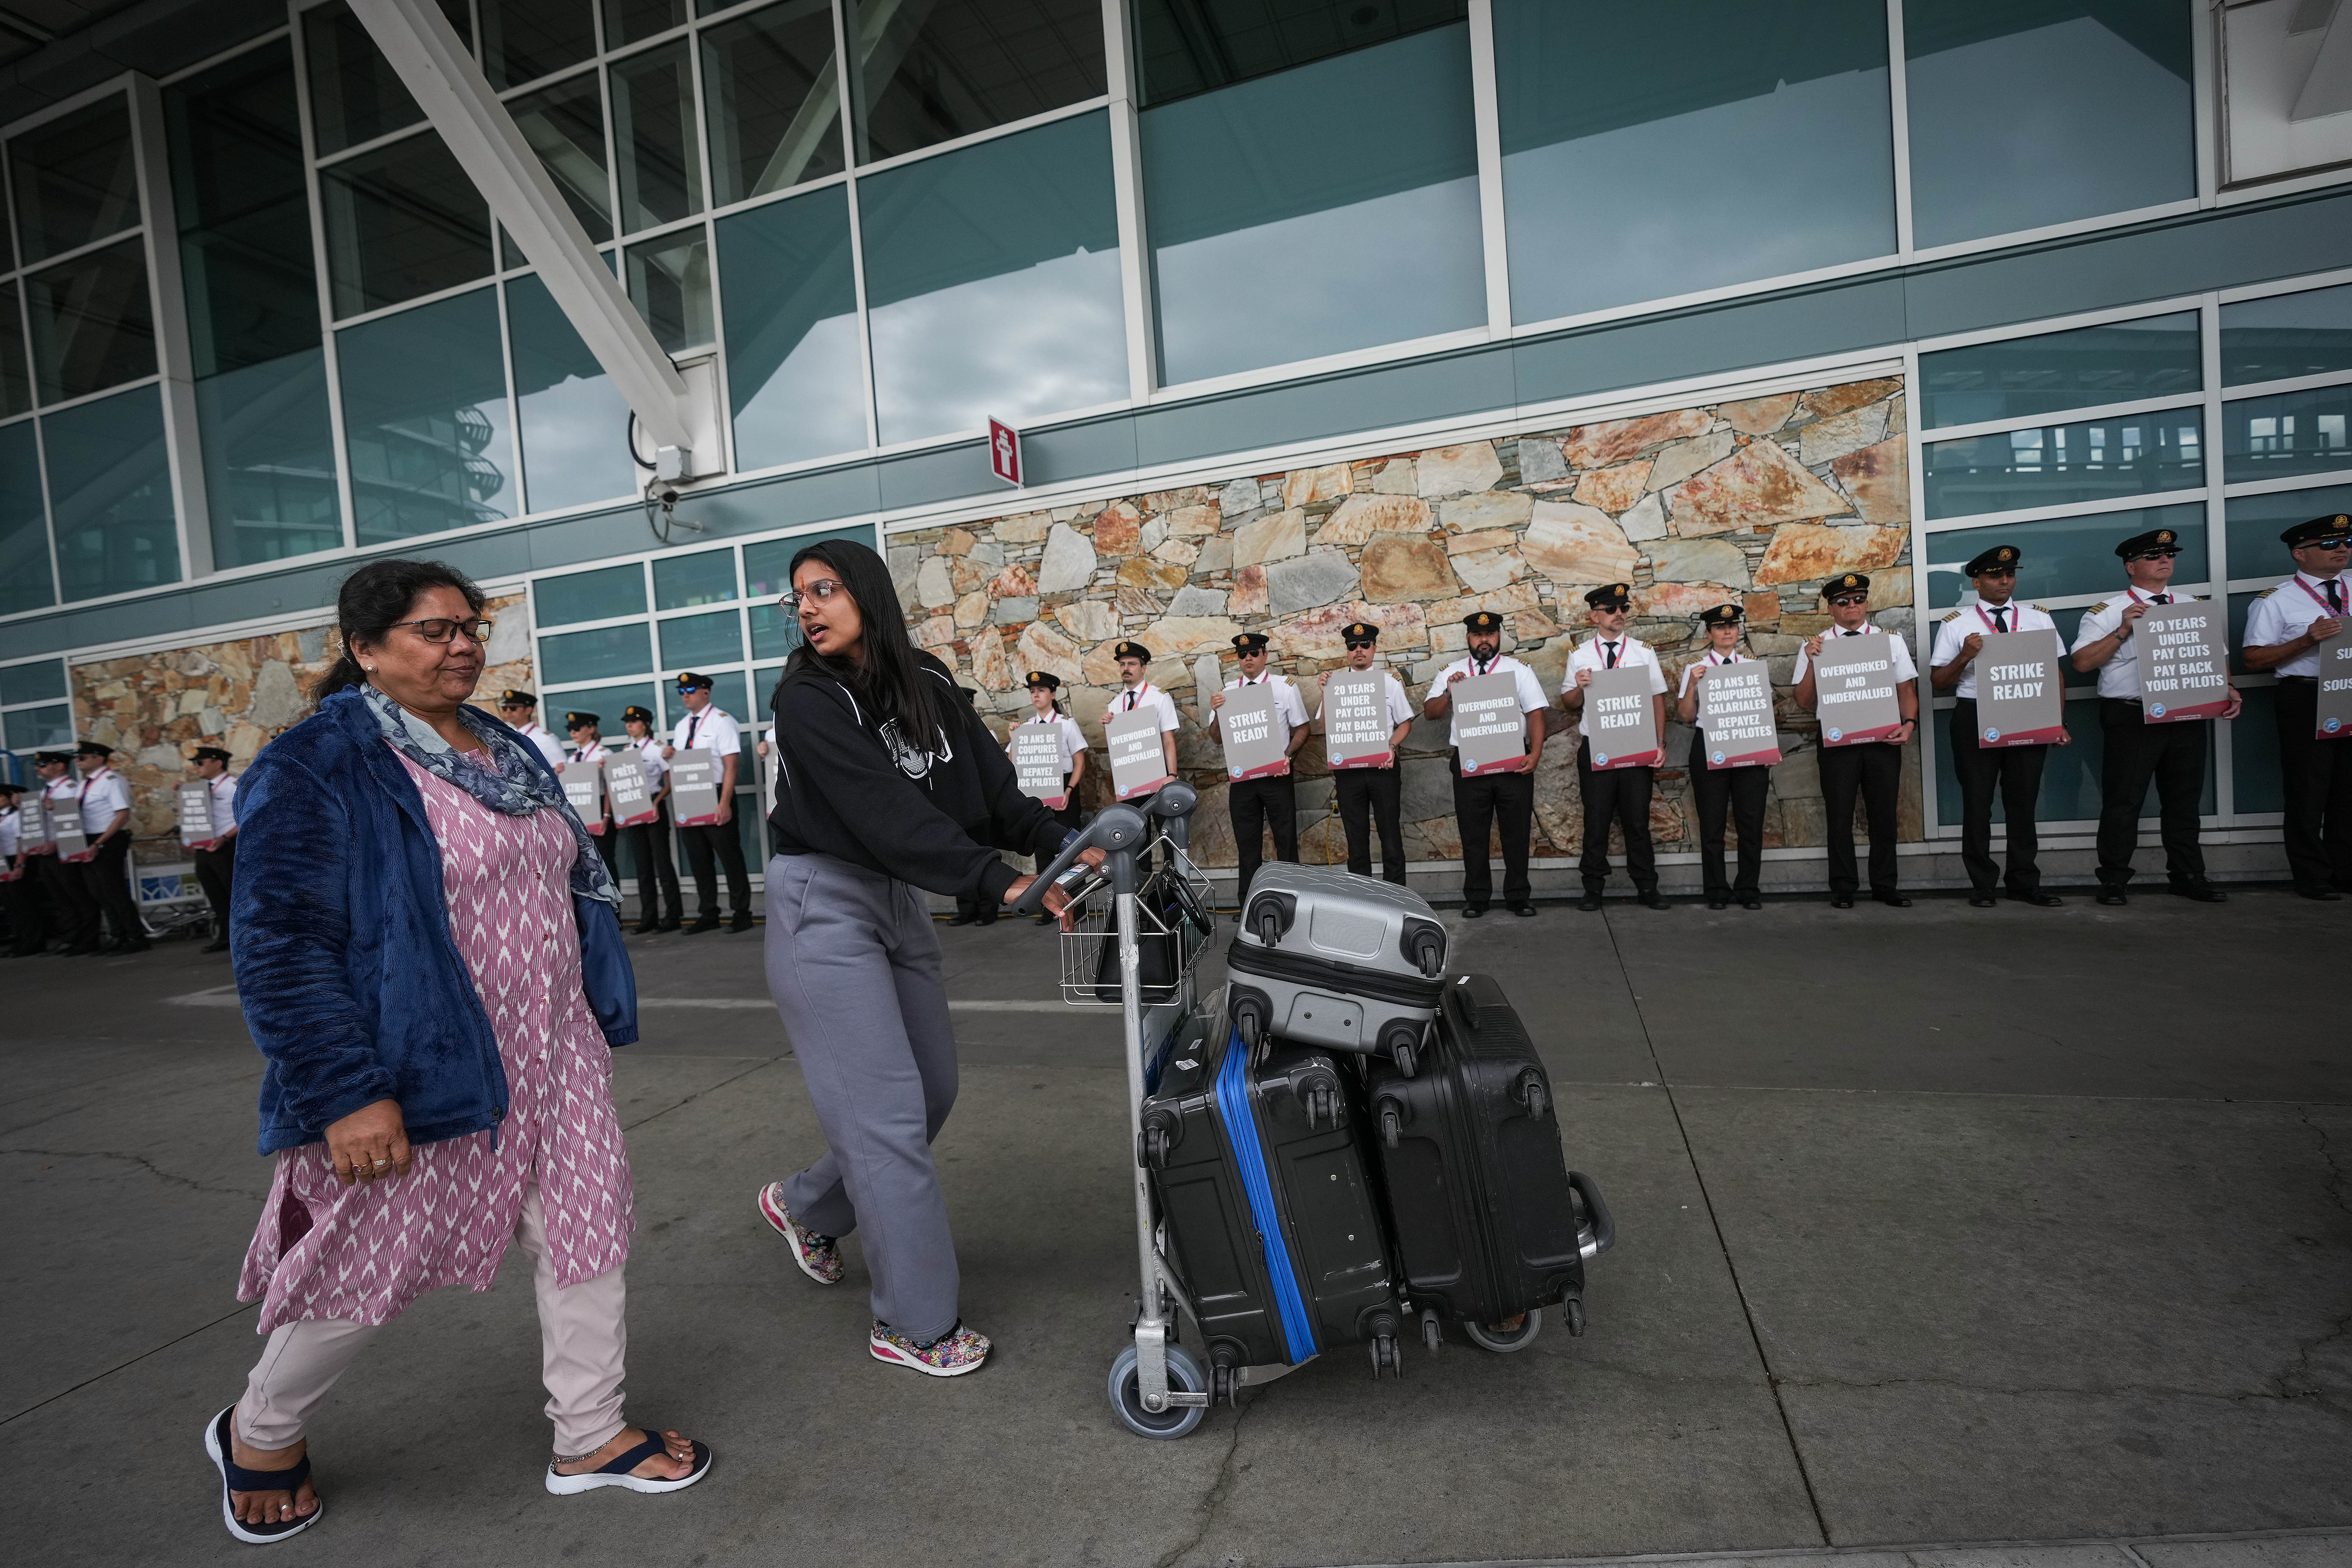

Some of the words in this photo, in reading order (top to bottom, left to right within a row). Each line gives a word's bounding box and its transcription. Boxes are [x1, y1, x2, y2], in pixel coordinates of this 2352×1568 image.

[2148, 621, 2165, 633] 20
[2167, 616, 2207, 631] YEARS
[2158, 631, 2200, 646] UNDER
[2153, 647, 2175, 660] PAY
[2178, 644, 2210, 658] CUTS
[1820, 659, 1888, 678] OVERWORKED
[1990, 662, 2044, 681] STRIKE
[2153, 664, 2175, 677] PAY
[2179, 661, 2213, 675] BACK
[1334, 685, 1345, 695] 20
[1348, 682, 1375, 694] YEARS
[1708, 679, 1721, 690] 20
[1724, 676, 1744, 688] ANS
[1746, 674, 1760, 686] DE
[1846, 676, 1866, 688] AND
[2145, 679, 2179, 692] YOUR
[2182, 674, 2224, 689] PILOTS
[1708, 686, 1763, 702] COUPURES
[1822, 686, 1892, 705] UNDERVALUED
[1993, 682, 2043, 700] READY
[1340, 695, 1370, 706] UNDER
[1458, 697, 1514, 713] OVERWORKED
[1596, 694, 1642, 713] STRIKE
[1707, 698, 1767, 715] SALARIALES
[1228, 709, 1268, 728] STRIKE
[1335, 707, 1352, 719] PAY
[1354, 706, 1377, 717] CUTS
[1479, 712, 1497, 723] AND
[1600, 711, 1641, 729] READY
[1335, 721, 1352, 732] PAY
[1354, 719, 1378, 731] BACK
[1718, 714, 1760, 729] REPAYEZ
[1111, 727, 1156, 745] OVERWORKED
[1233, 726, 1268, 744] READY
[1329, 733, 1353, 744] YOUR
[1355, 731, 1386, 742] PILOTS
[1460, 722, 1519, 738] UNDERVALUED
[1709, 730, 1730, 742] VOS
[1731, 725, 1772, 740] PILOTES
[1019, 735, 1028, 744] 20
[1030, 734, 1045, 744] ANS
[1046, 734, 1056, 743] DE
[1128, 741, 1142, 753] AND
[1018, 744, 1057, 755] COUPURES
[1113, 748, 1160, 767] UNDERVALUED
[1016, 755, 1059, 765] SALARIALES
[612, 763, 638, 778] PRÊTS
[1023, 767, 1053, 777] REPAYEZ
[565, 782, 593, 794] STRIKE
[610, 778, 633, 792] POUR
[634, 775, 644, 787] LA
[1032, 777, 1061, 787] PILOTES
